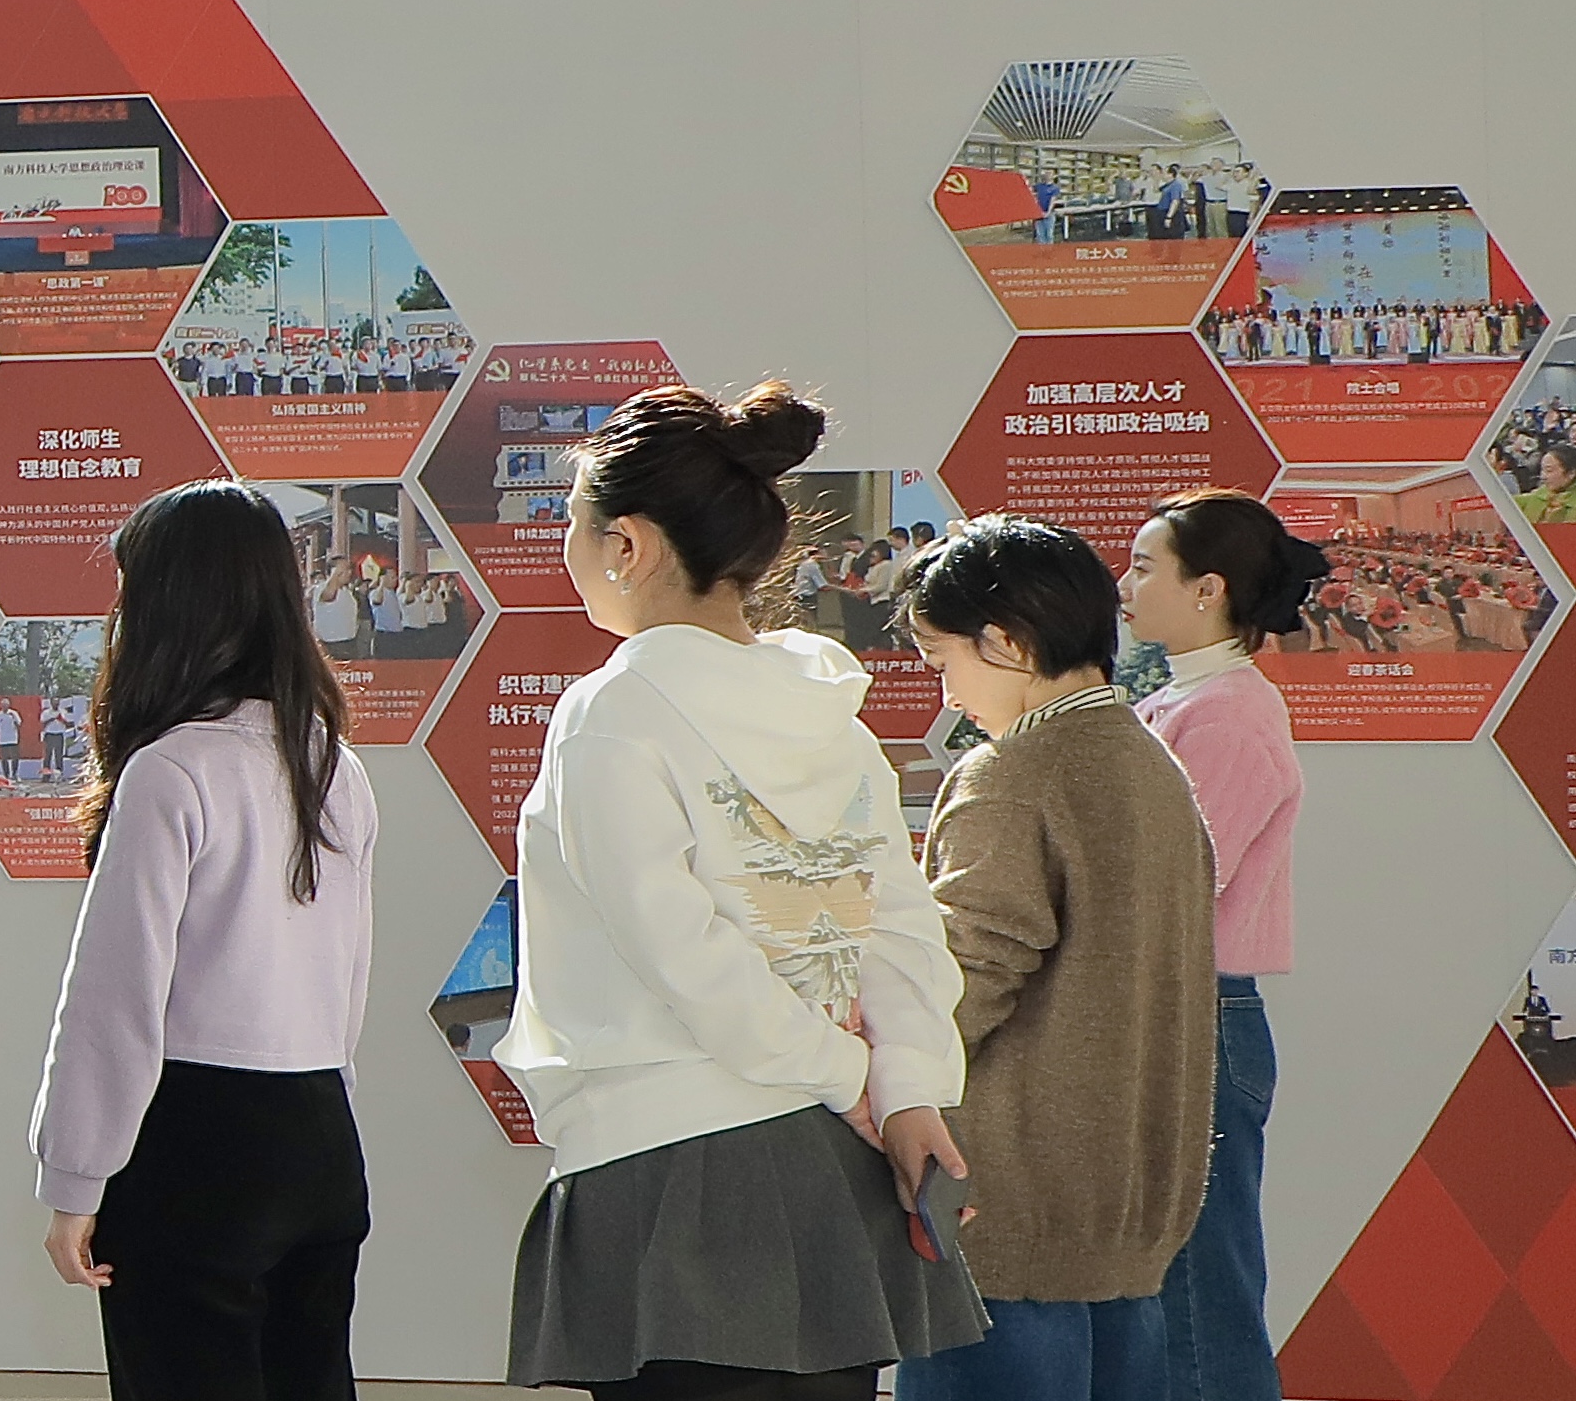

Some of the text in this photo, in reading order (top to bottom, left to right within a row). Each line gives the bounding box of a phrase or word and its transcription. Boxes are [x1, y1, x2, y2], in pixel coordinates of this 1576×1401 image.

[1074, 247, 1129, 260] 院士入党
[1025, 380, 1186, 405] 加强高层次人才
[271, 402, 367, 416] 弘扬爱国主义精神
[1003, 411, 1211, 436] 政治引领和政治吸纳
[38, 427, 122, 450] 深化师生
[17, 456, 143, 480] 理想信念教育
